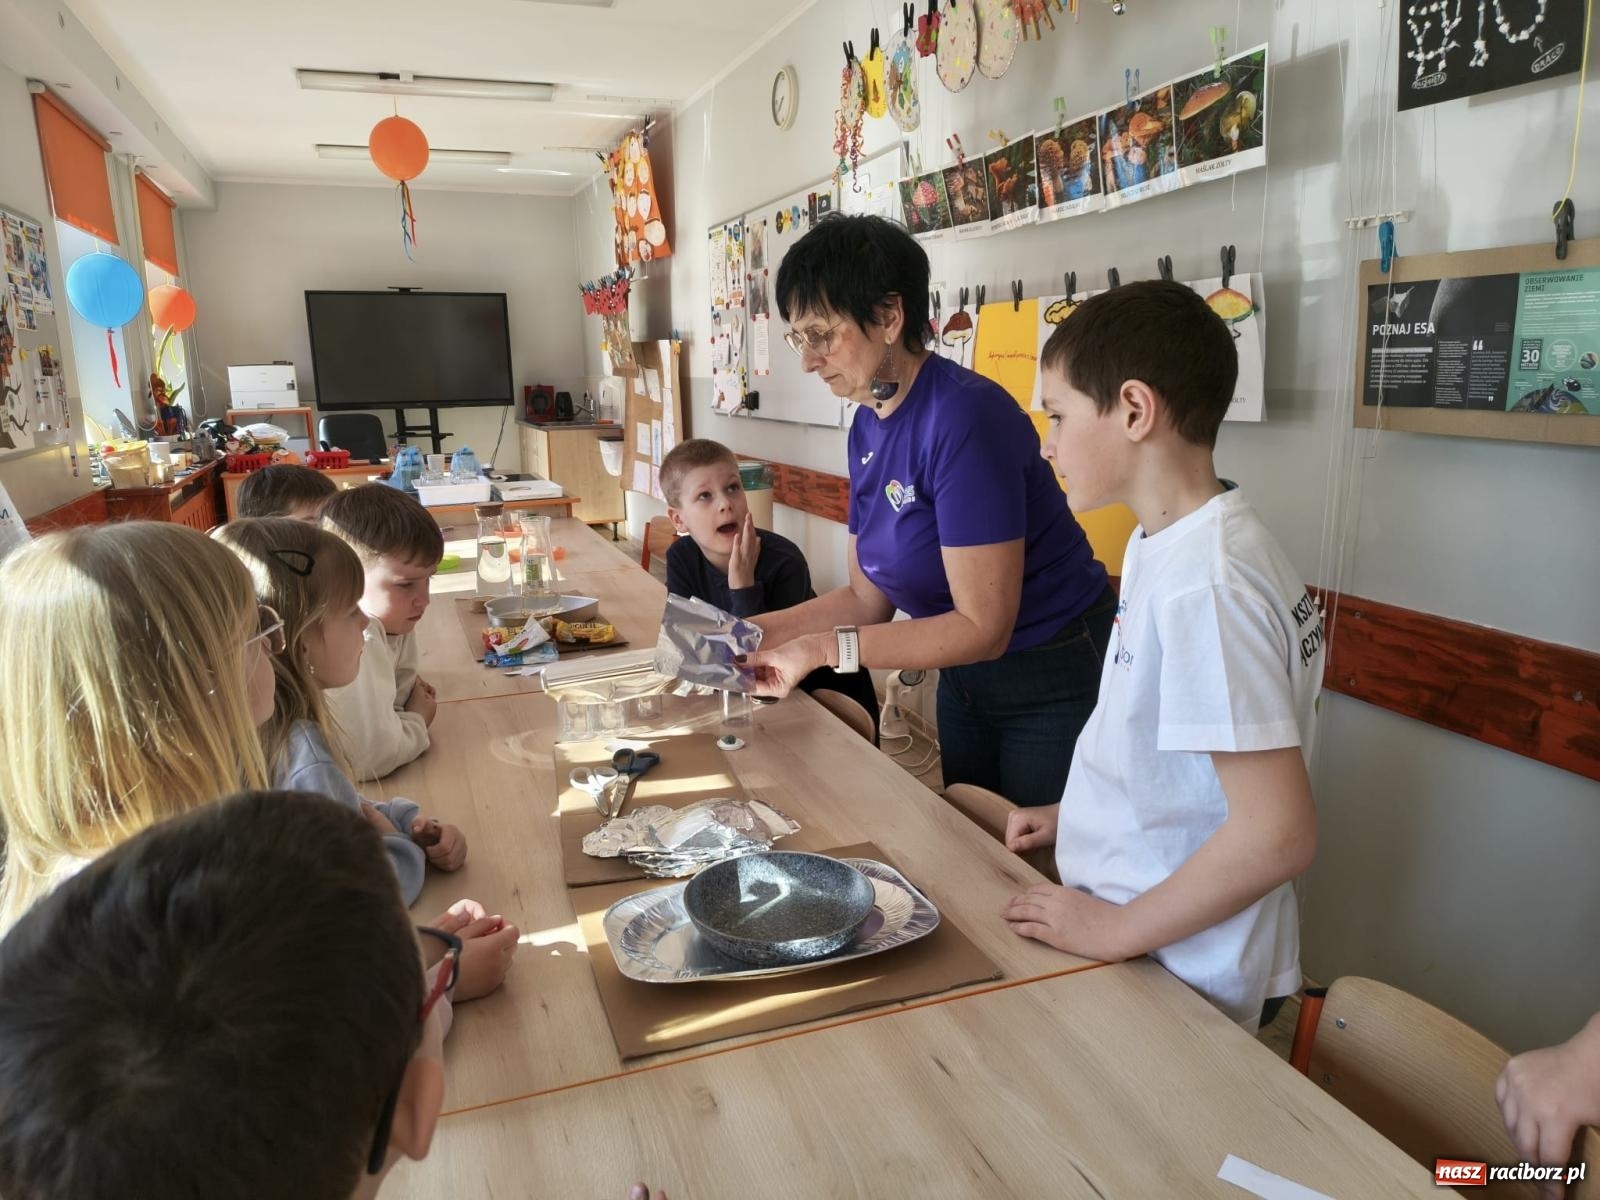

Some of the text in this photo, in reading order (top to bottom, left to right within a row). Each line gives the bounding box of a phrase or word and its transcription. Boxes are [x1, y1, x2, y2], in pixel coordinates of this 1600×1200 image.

[1525, 274, 1584, 285] OBSERWOWANIE
[1525, 284, 1545, 293] ZIEMI
[1372, 322, 1435, 336] POZNAJ ESA
[1521, 349, 1540, 362] 30
